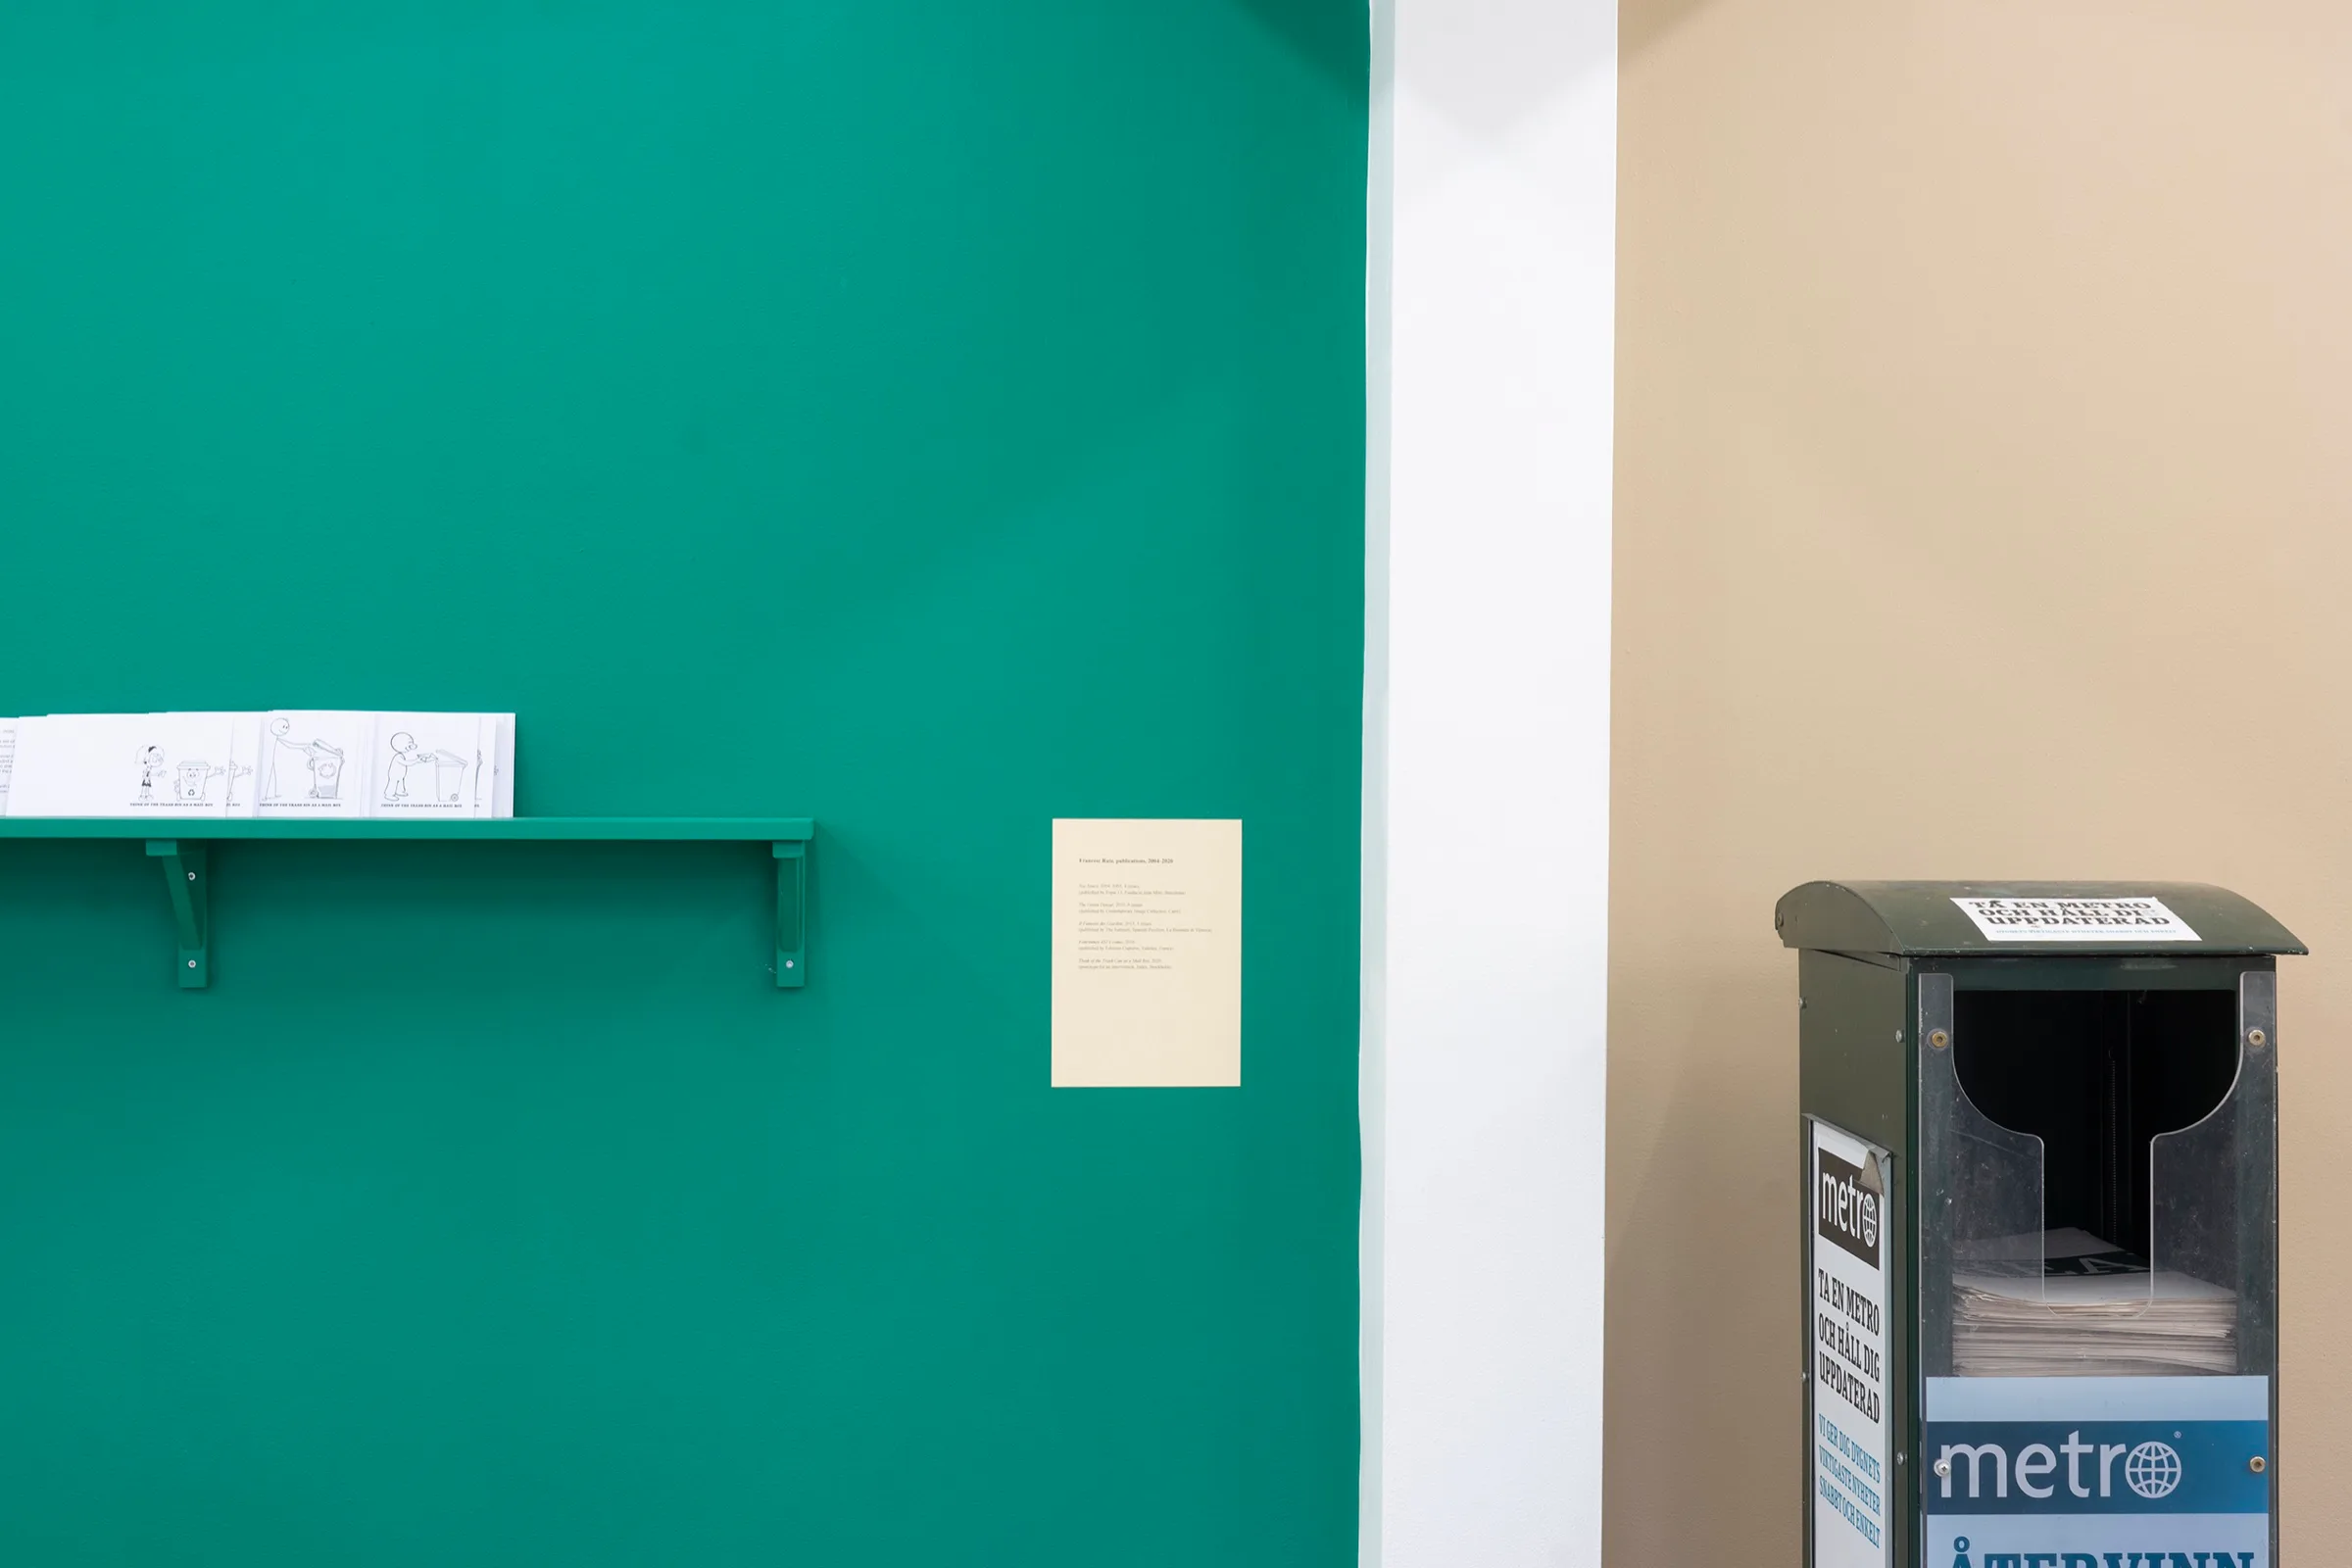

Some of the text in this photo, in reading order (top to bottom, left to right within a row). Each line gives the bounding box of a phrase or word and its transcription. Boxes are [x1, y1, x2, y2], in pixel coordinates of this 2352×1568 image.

[1986, 916, 2171, 926] UPPDATERAD
[2038, 908, 2109, 917] HÅLL
[1822, 1171, 1878, 1248] metro
[1818, 1267, 1880, 1337] TA EN METRO
[1818, 1312, 1880, 1383] OCH HÅLL DIG
[1818, 1350, 1880, 1424] UPPDATERAD
[1818, 1412, 1826, 1437] VI
[1826, 1419, 1838, 1448] GER
[1940, 1430, 2182, 1498] metro
